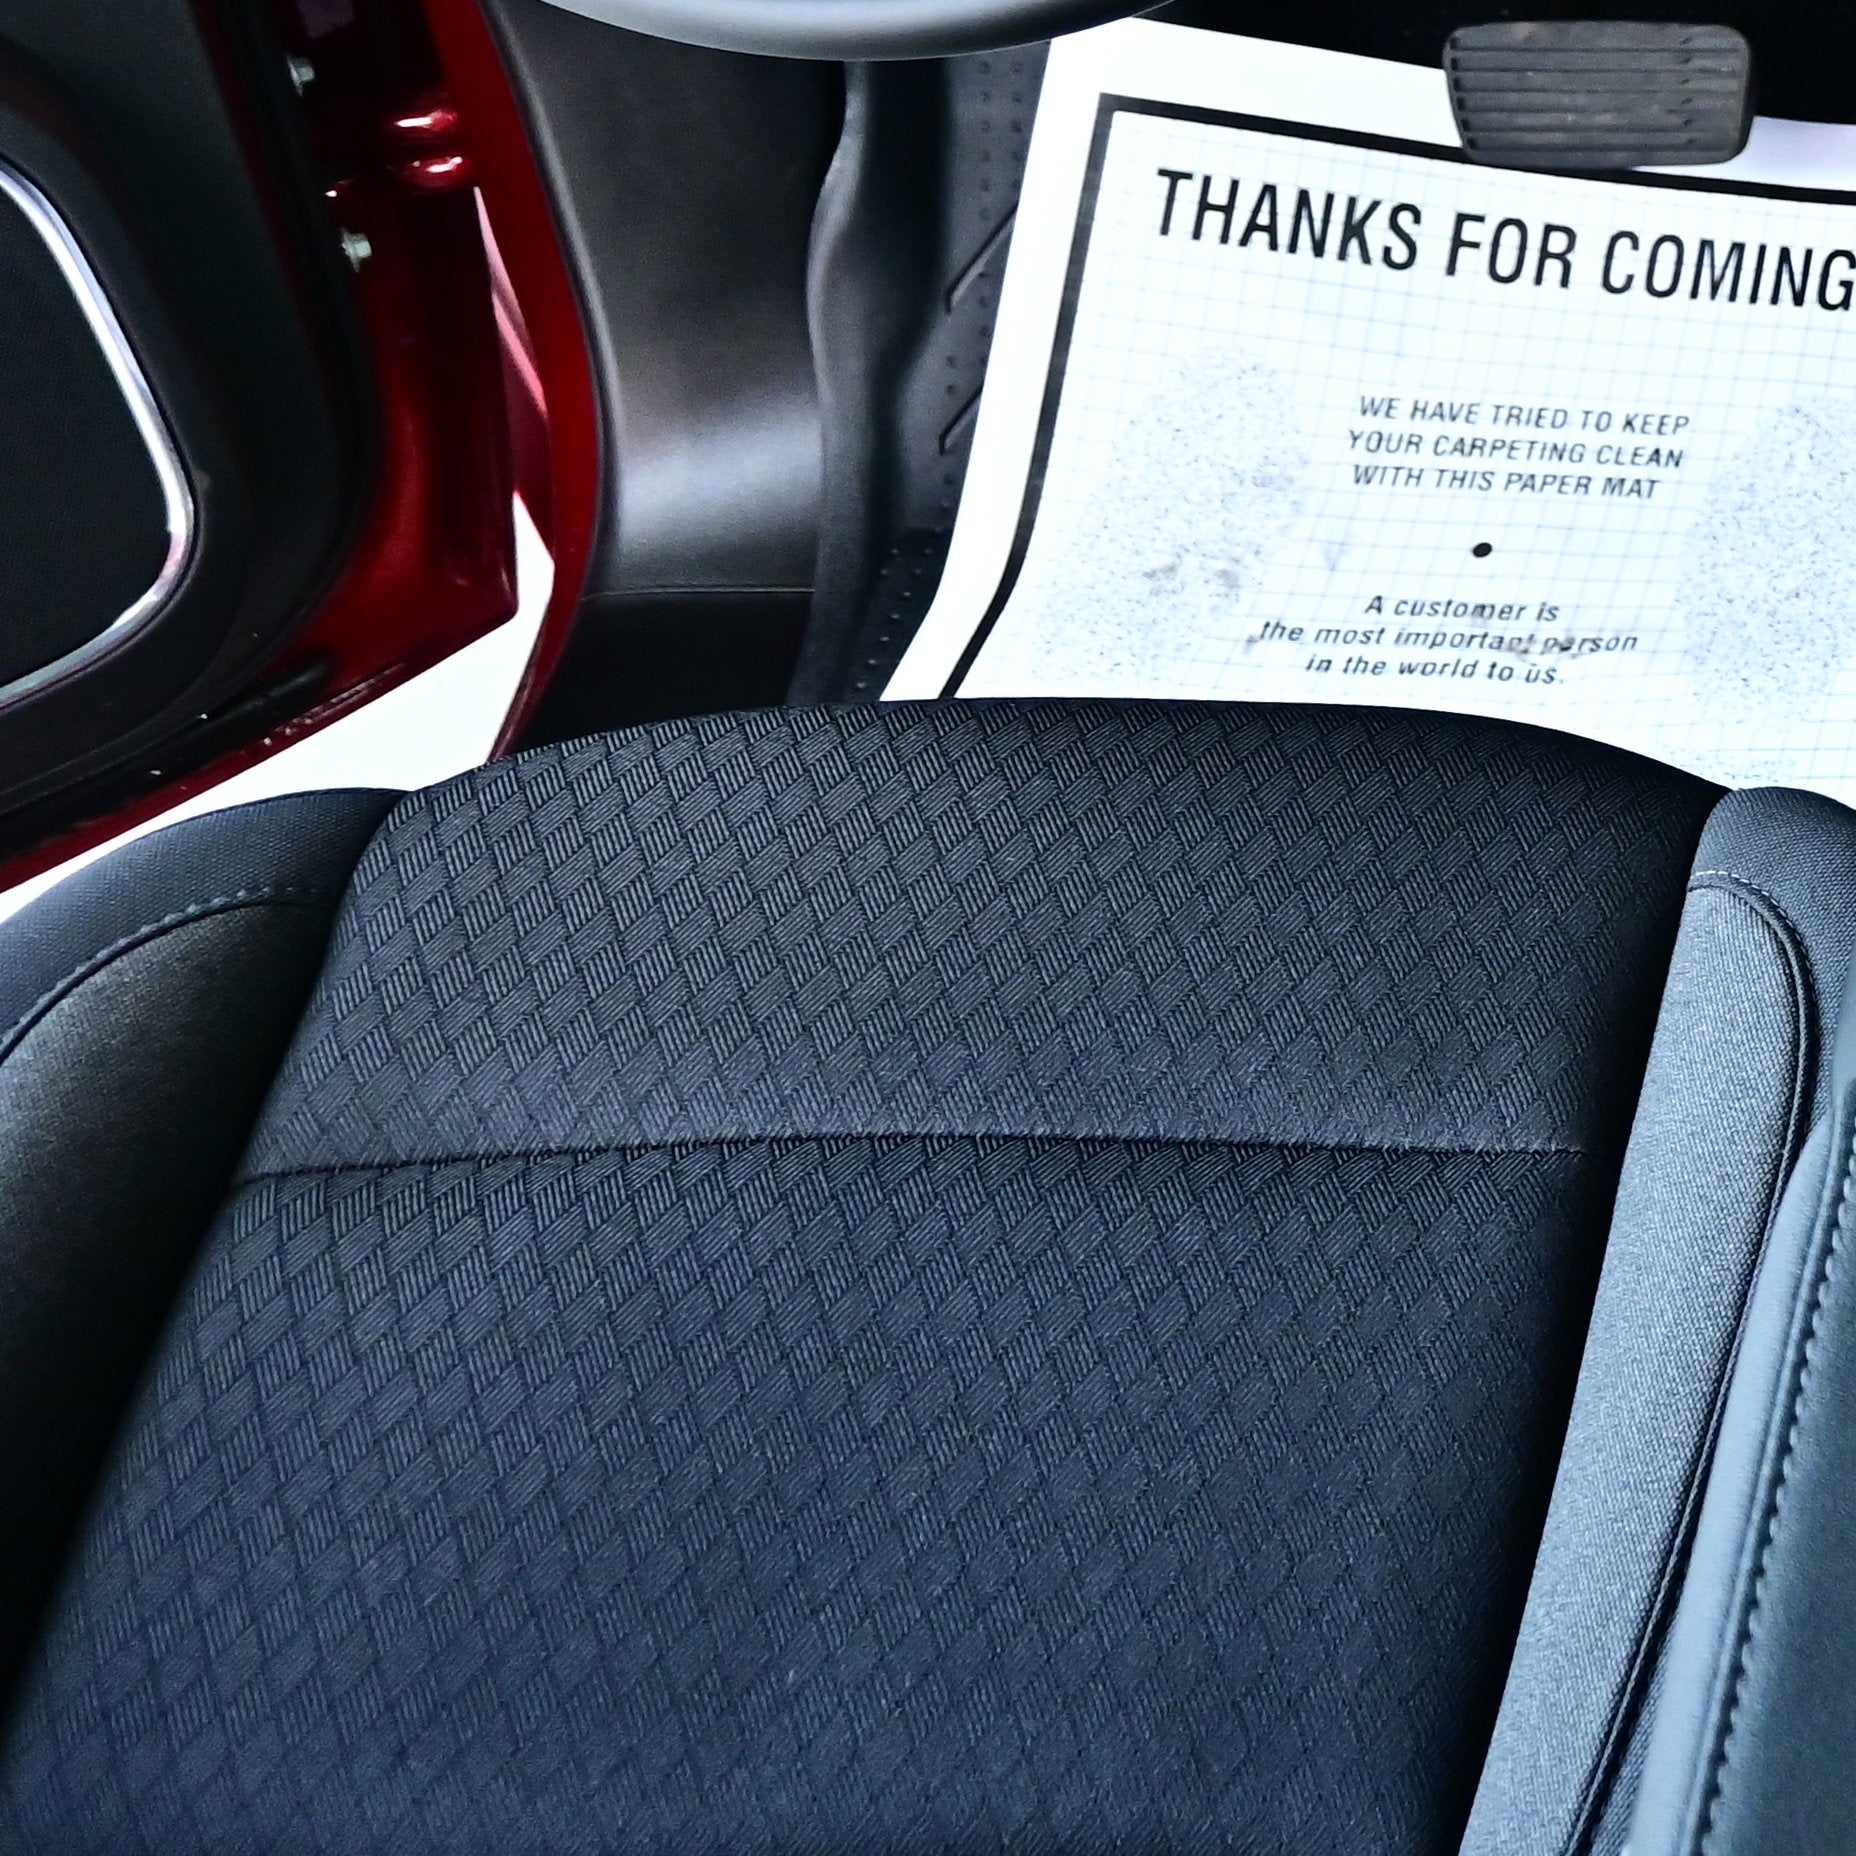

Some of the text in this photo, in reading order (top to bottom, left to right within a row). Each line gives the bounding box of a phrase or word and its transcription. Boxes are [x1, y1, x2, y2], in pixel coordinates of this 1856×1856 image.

[1156, 168, 1423, 272] THANKS
[1446, 213, 1578, 290] FOR
[1359, 396, 1690, 437] WE HAVE TRIED TO KEEP
[1348, 429, 1684, 470] YOUR CARPETING CLEAN
[1353, 464, 1662, 500] WITH THIS PAPER MAT
[1365, 595, 1560, 623] A customer is
[1259, 620, 1638, 657] the most important person
[1306, 655, 1565, 685] in the world to us.
